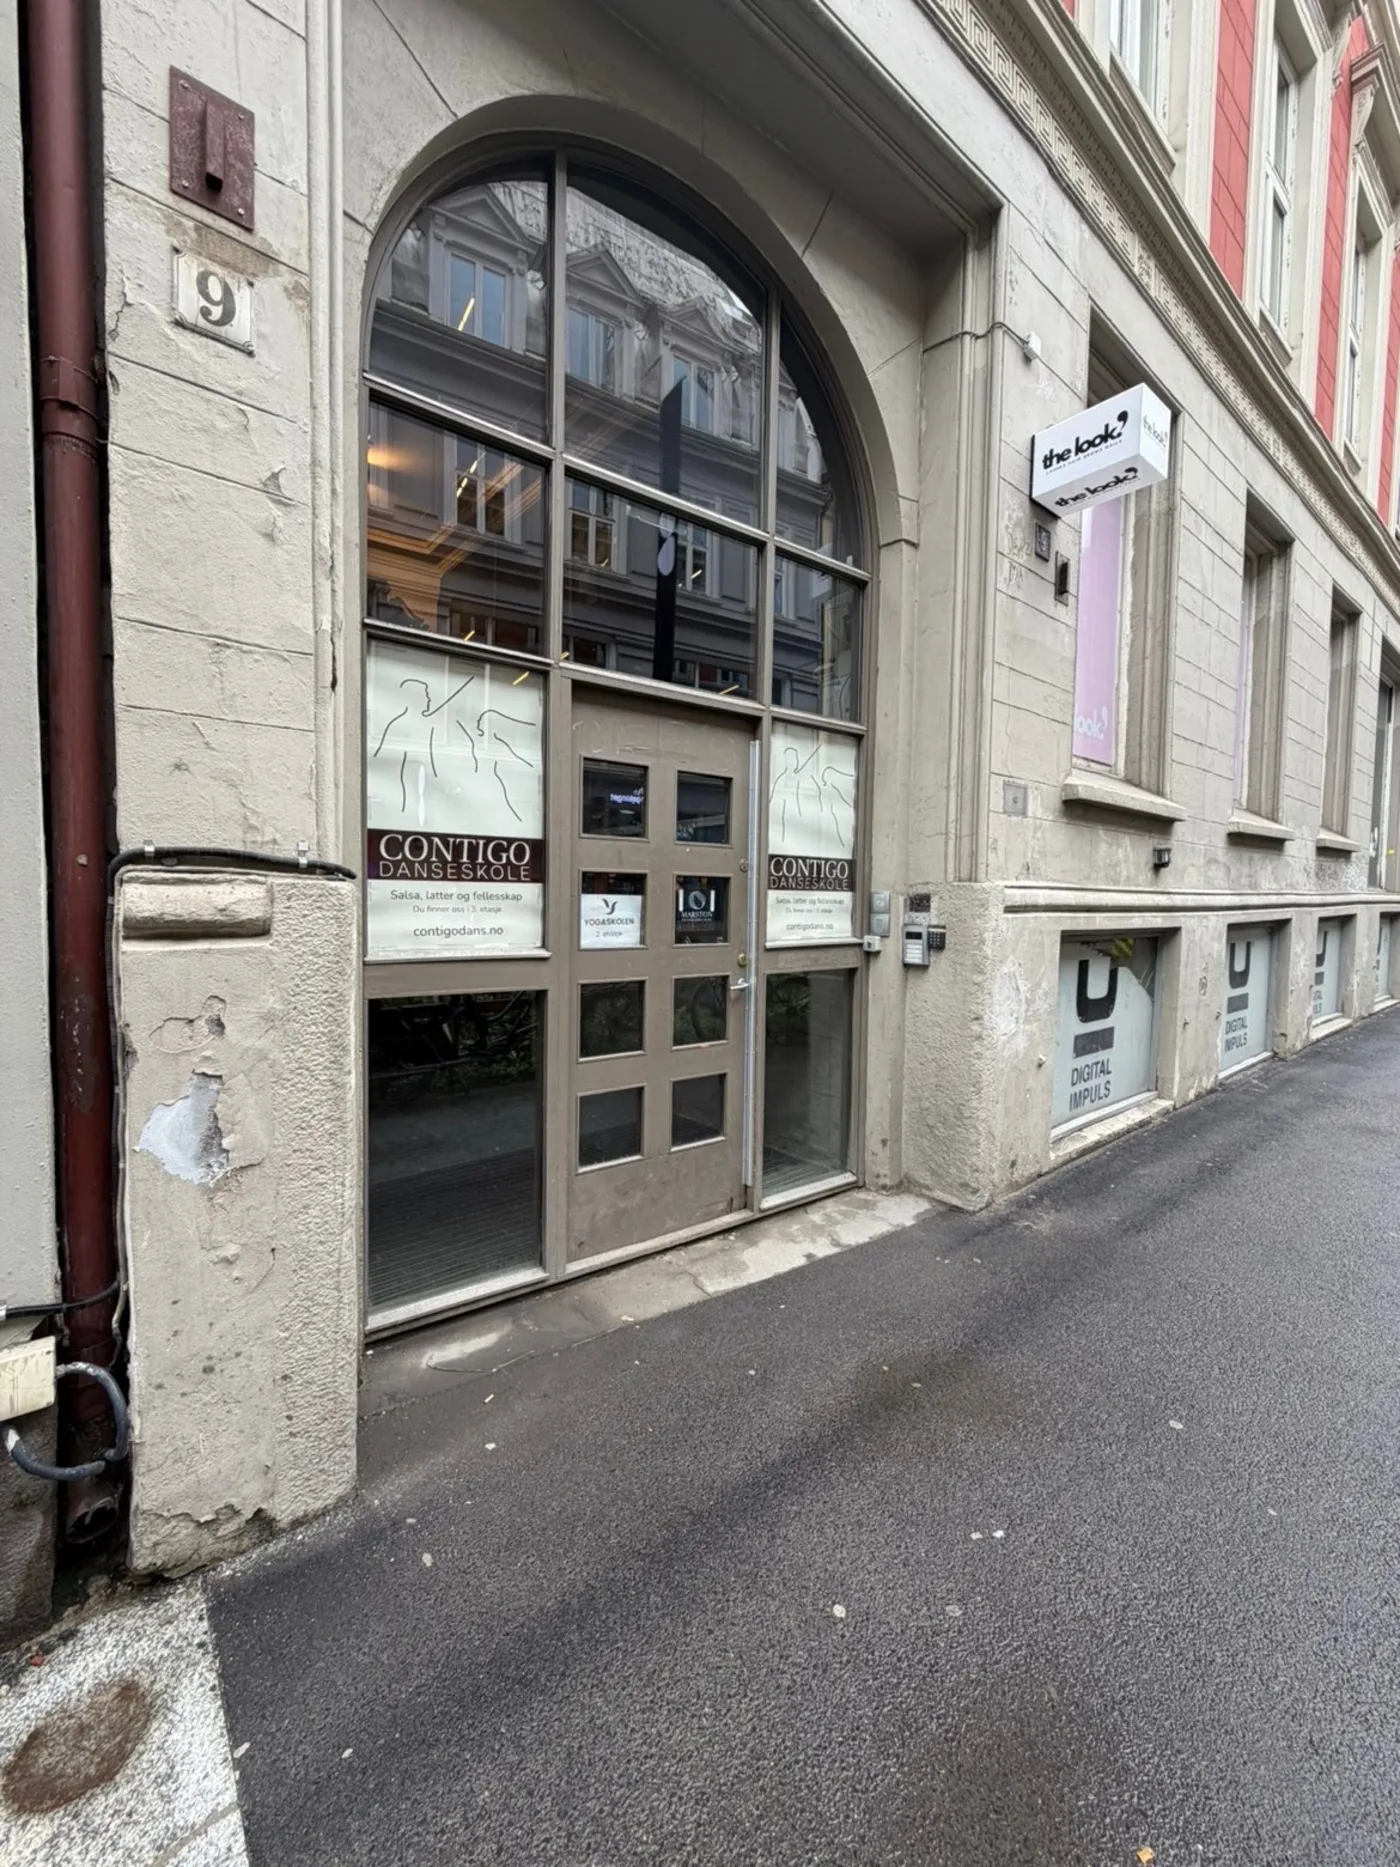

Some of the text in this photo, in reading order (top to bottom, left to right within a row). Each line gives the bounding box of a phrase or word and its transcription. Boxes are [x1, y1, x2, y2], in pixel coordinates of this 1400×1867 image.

[196, 270, 236, 327] 9
[1042, 448, 1072, 470] the
[1054, 492, 1087, 507] the
[379, 833, 531, 865] CONTIGO
[379, 860, 531, 881] DANSESKOLE
[770, 857, 849, 879] CONTIGO
[769, 876, 849, 890] DANSESKOLE
[390, 889, 523, 903] Salsa, latter og fellesskap
[413, 905, 425, 913] Du
[426, 905, 450, 913] finner
[479, 905, 503, 914] etasje
[413, 925, 504, 938] contigodans.no
[584, 917, 635, 927] YOGASKOLEN
[1225, 1015, 1248, 1035] DIGITAL
[1071, 1058, 1112, 1087] DIGITAL
[1069, 1080, 1112, 1112] IMPULS
